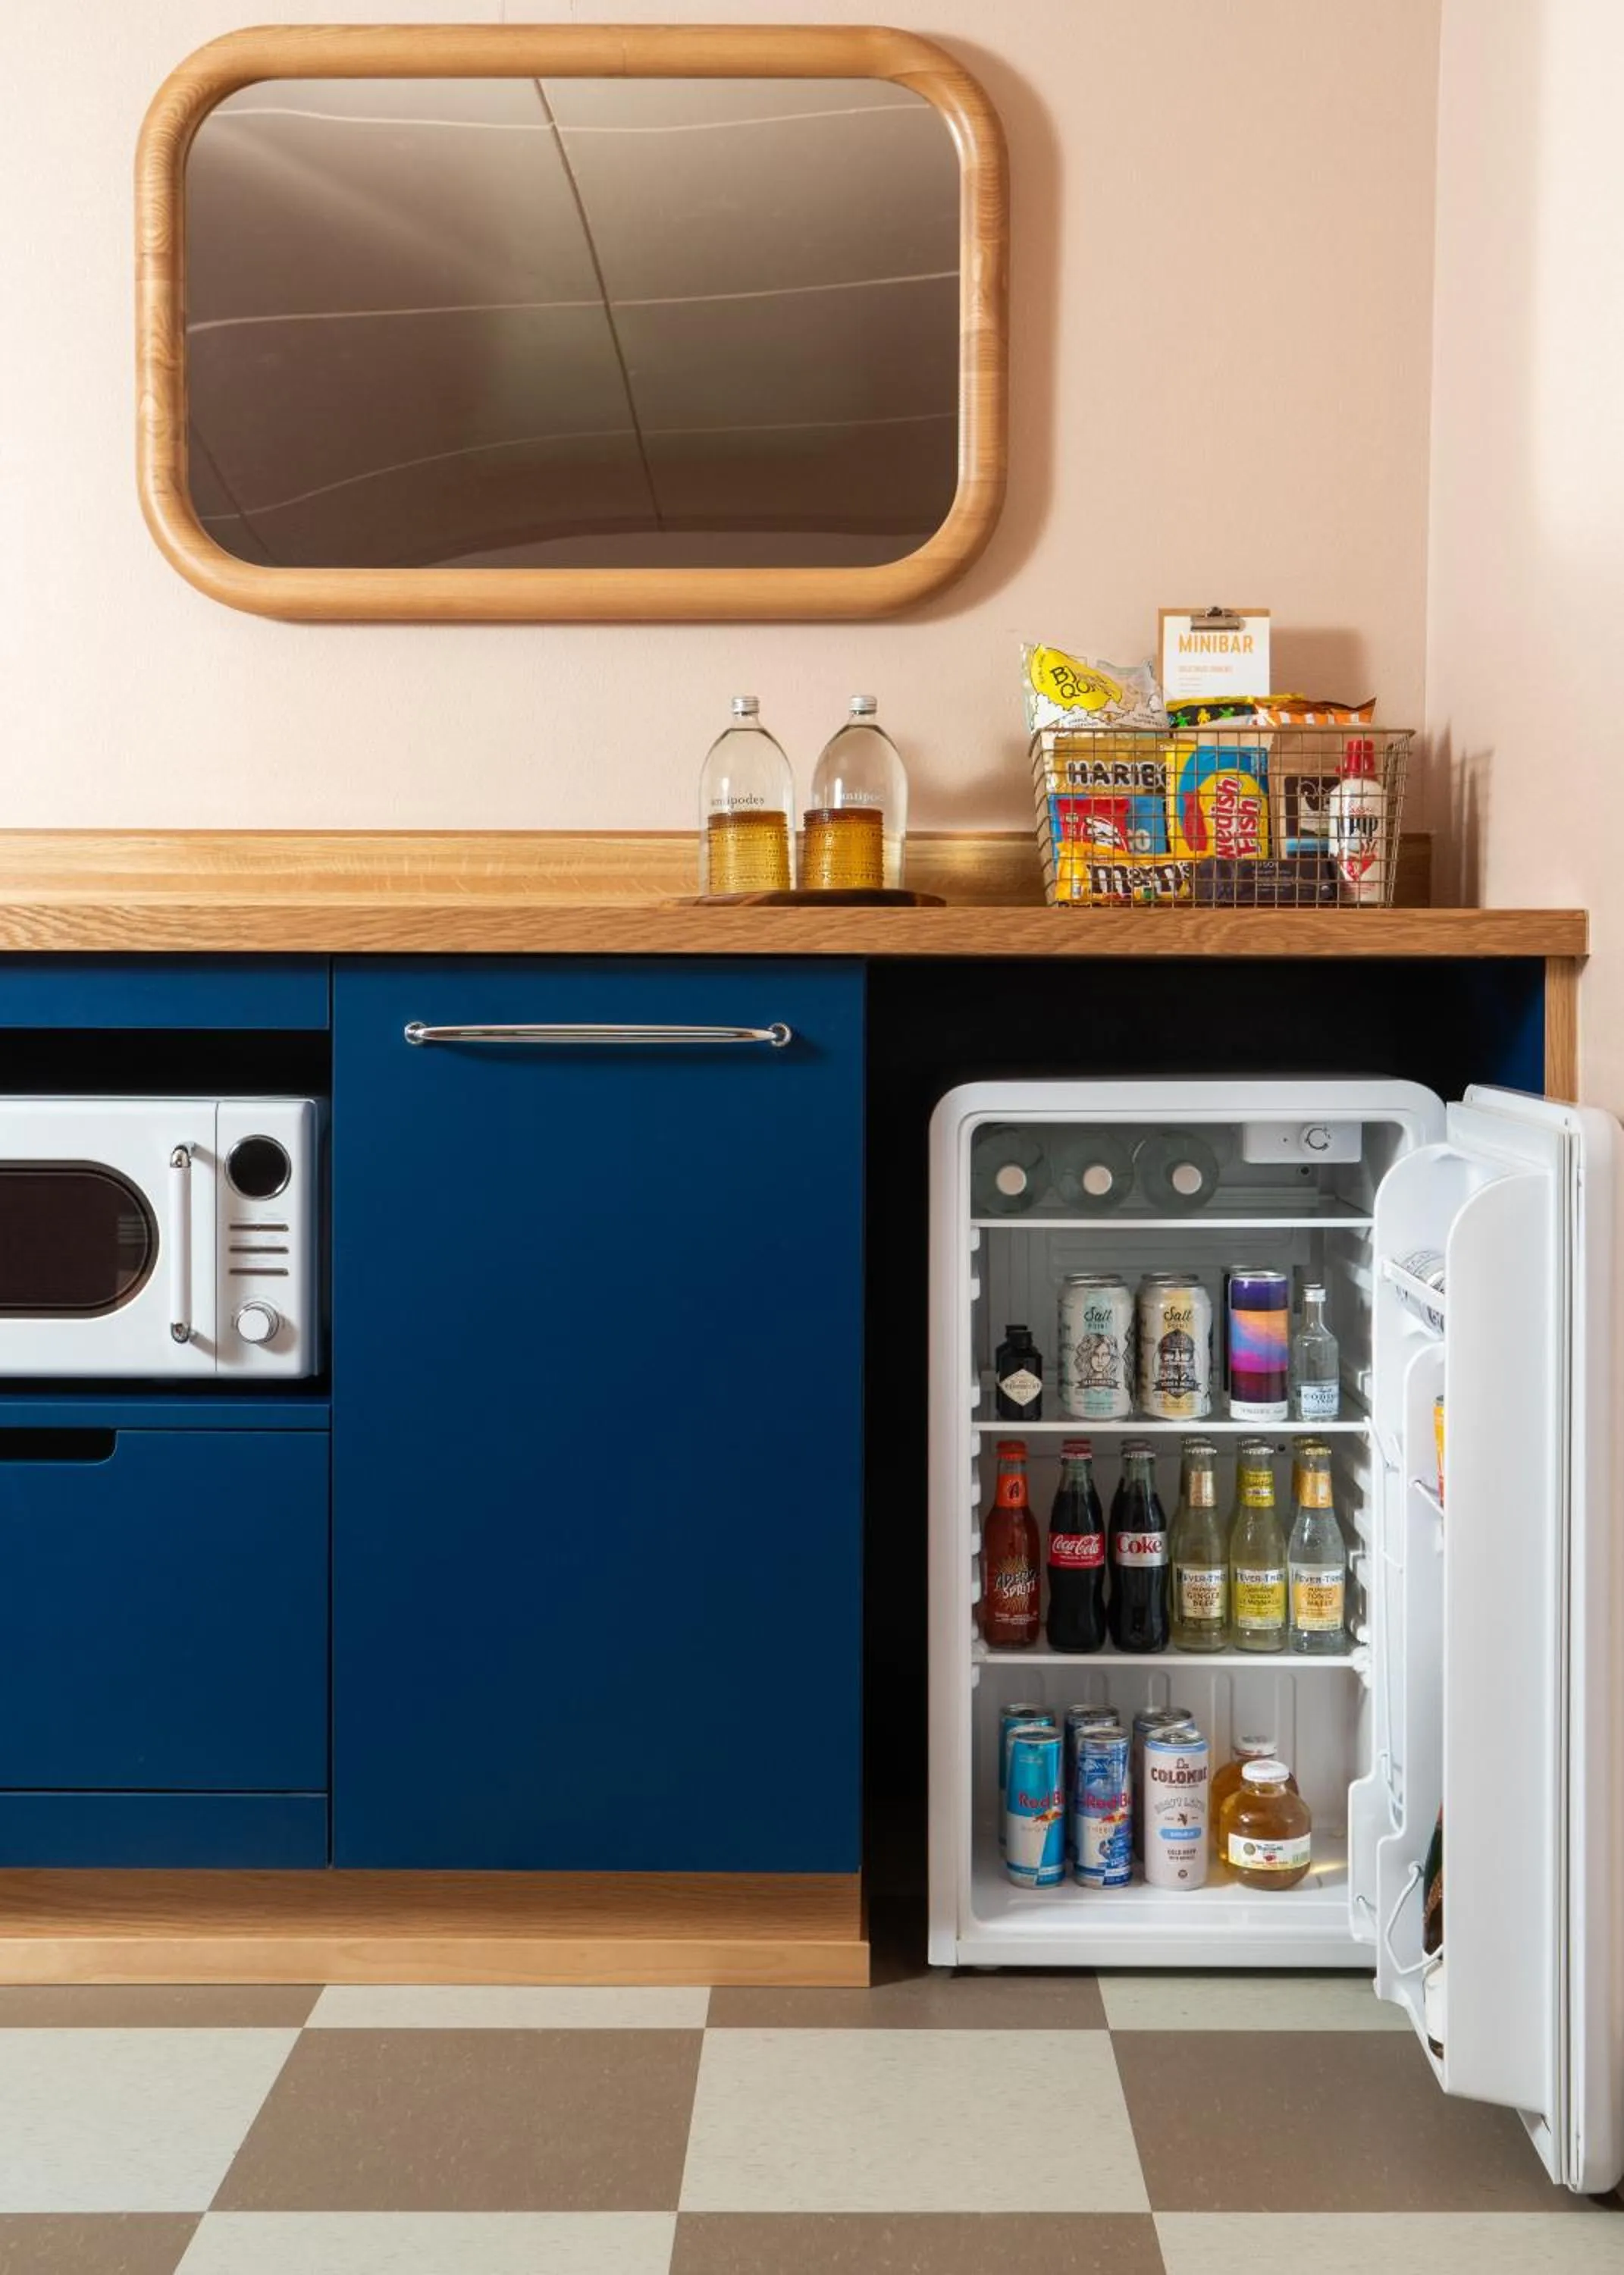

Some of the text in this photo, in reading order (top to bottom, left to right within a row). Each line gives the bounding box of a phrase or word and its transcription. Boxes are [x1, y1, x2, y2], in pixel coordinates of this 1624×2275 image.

[1178, 633, 1254, 654] MINIBAR
[1235, 799, 1261, 856] Fish
[1052, 1533, 1099, 1555] Coca-Cola
[1117, 1533, 1162, 1554] Coke
[1018, 1792, 1050, 1808] Red
[1086, 1793, 1117, 1809] Red
